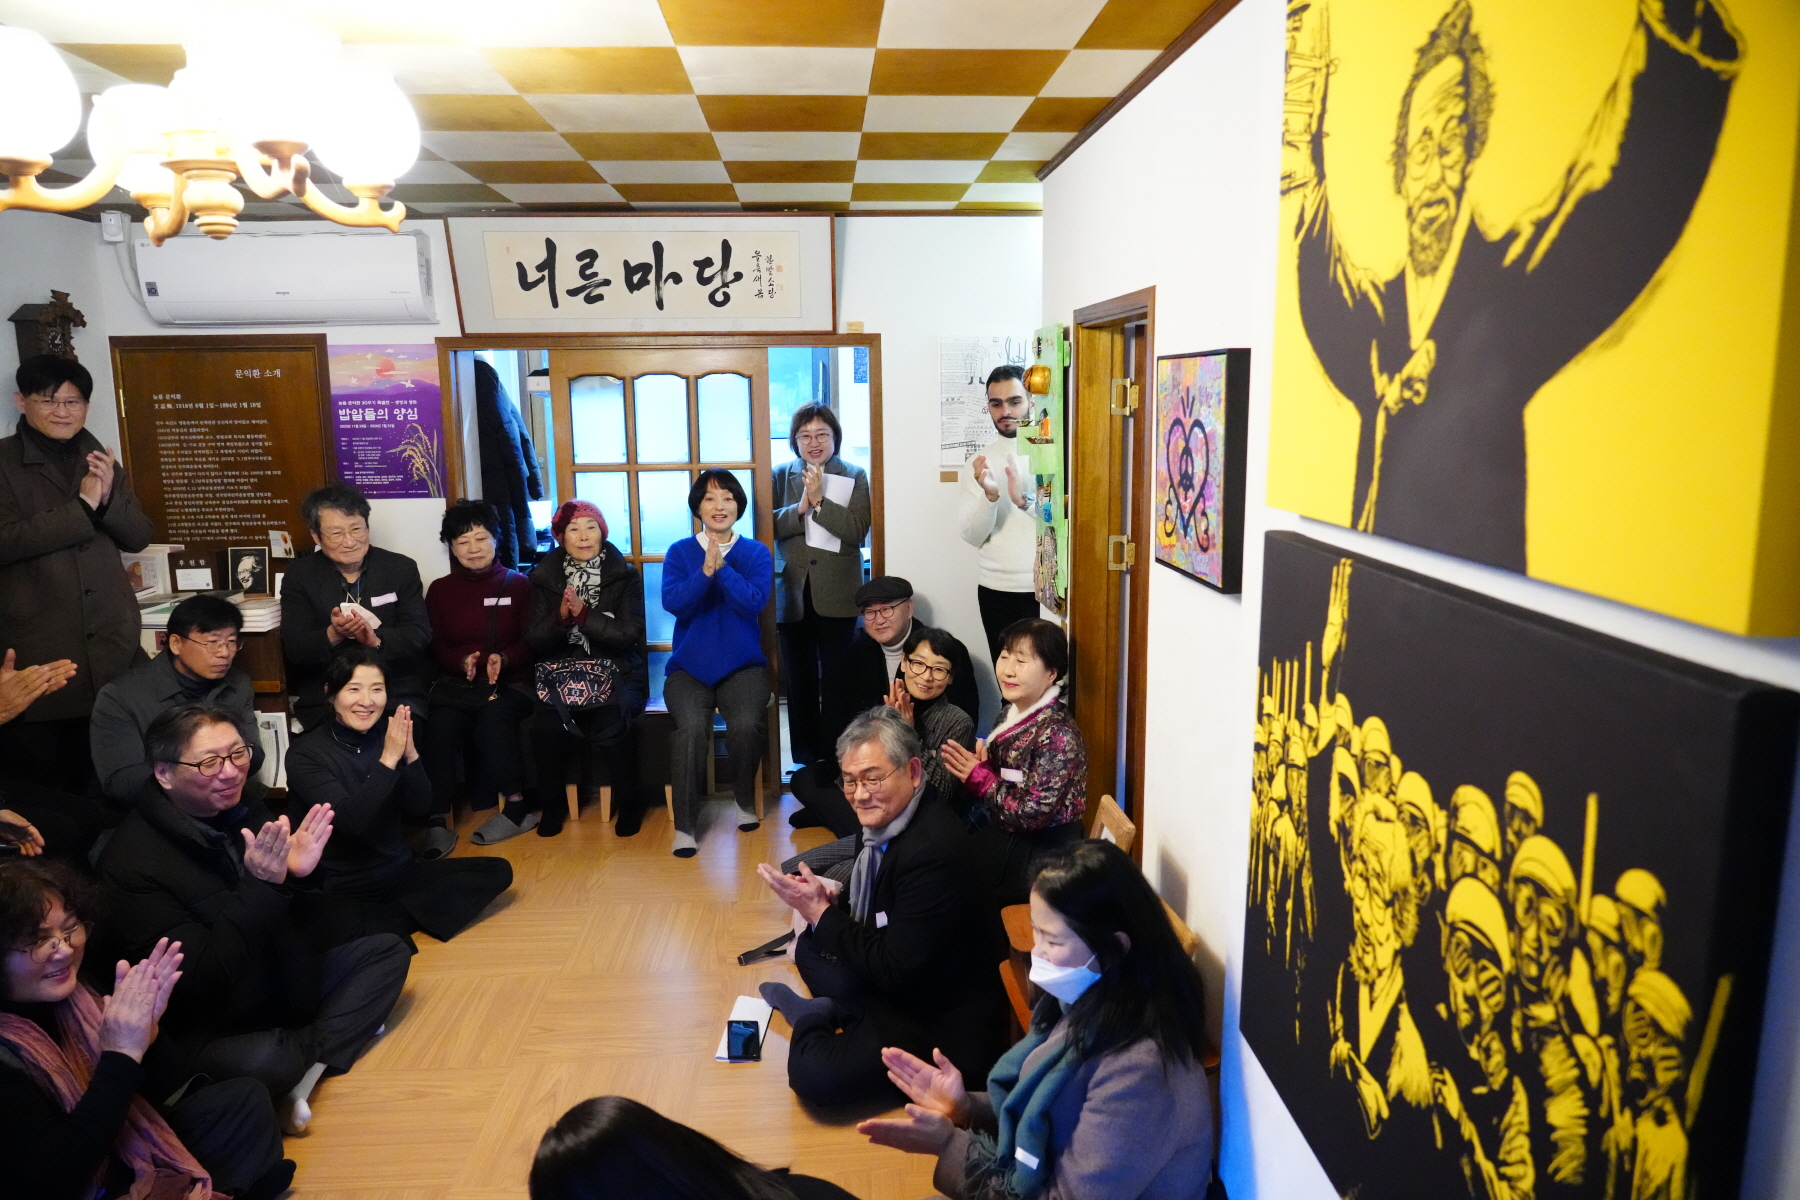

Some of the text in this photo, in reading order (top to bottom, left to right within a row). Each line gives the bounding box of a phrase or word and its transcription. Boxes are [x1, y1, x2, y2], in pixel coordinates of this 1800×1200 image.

[235, 369, 281, 378] 문익환 소개
[338, 408, 418, 420] 밥알들의 양심
